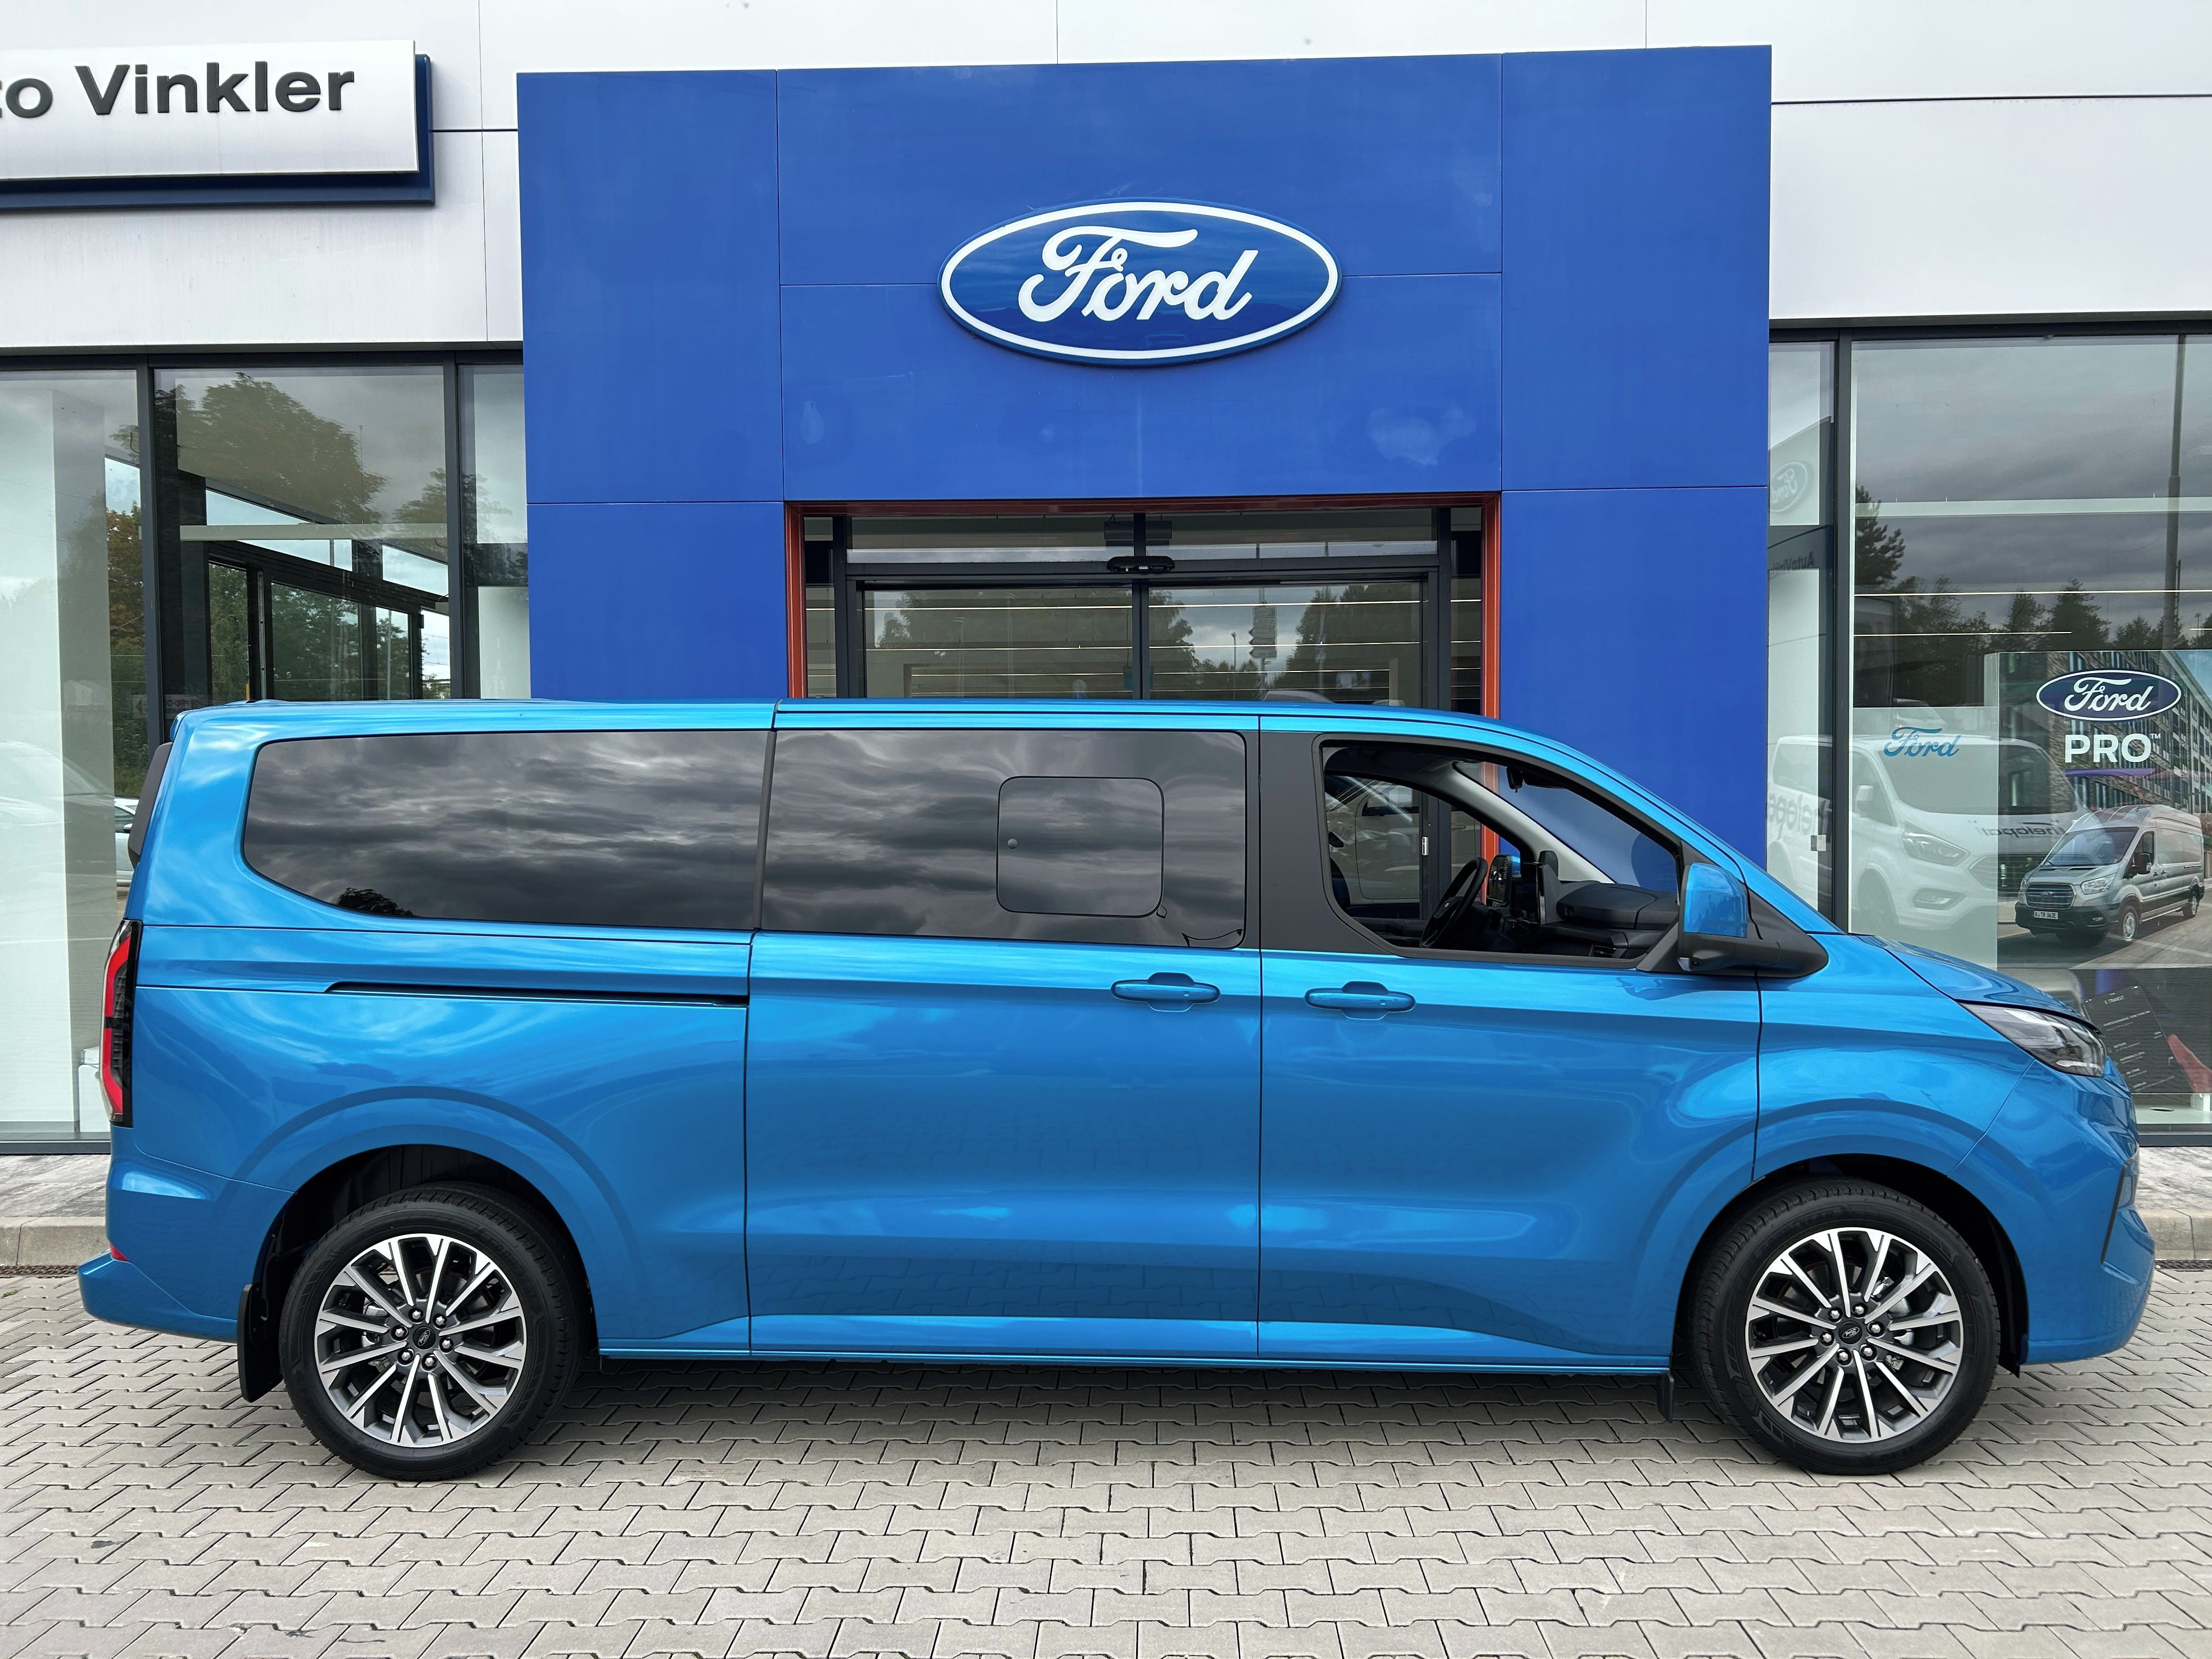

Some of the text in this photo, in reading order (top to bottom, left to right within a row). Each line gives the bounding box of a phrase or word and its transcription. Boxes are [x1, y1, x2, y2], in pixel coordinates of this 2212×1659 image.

[0, 60, 355, 119] o Vinkler
[1018, 225, 1259, 322] Ford
[2064, 676, 2154, 712] Ford
[1883, 726, 1962, 757] Ford
